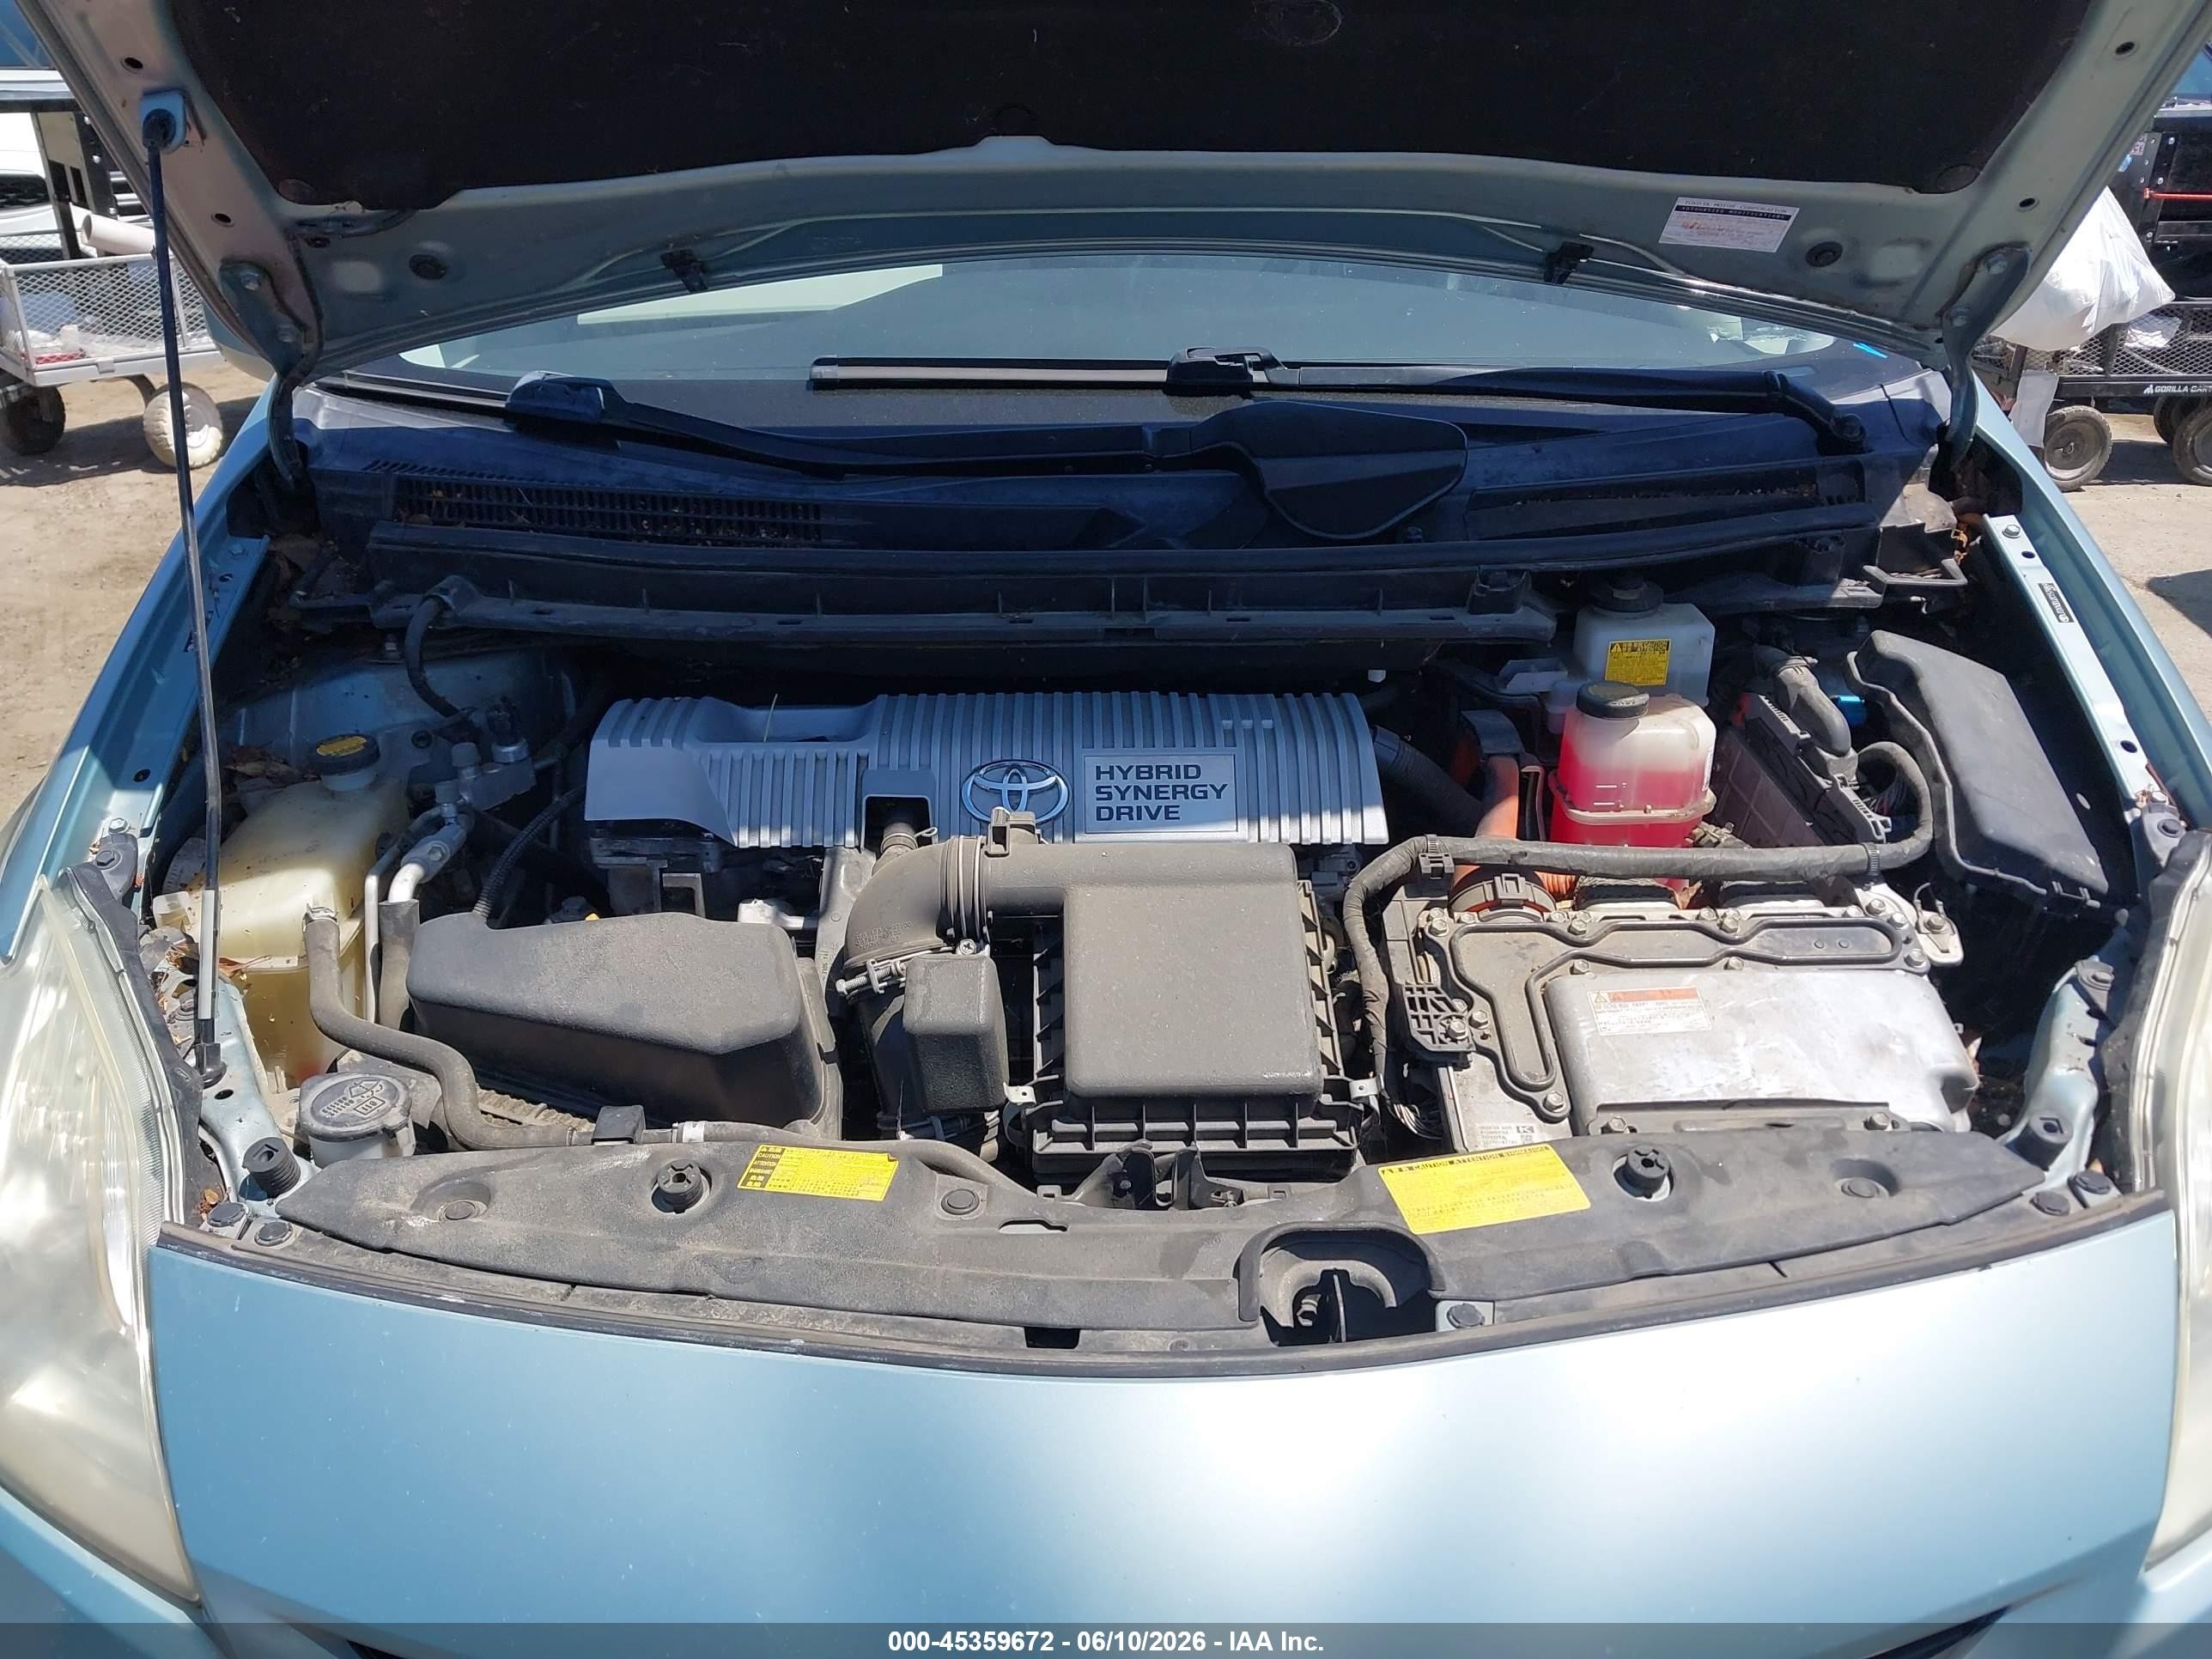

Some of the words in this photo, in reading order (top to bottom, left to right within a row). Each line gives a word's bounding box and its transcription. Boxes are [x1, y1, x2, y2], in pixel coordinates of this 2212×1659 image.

[1096, 764, 1201, 781] HYBRID
[1096, 783, 1228, 801] SYNERGY
[1096, 805, 1181, 821] DRIVE
[1414, 1160, 1449, 1170] CAUTION
[1455, 1153, 1499, 1165] ATTENTION
